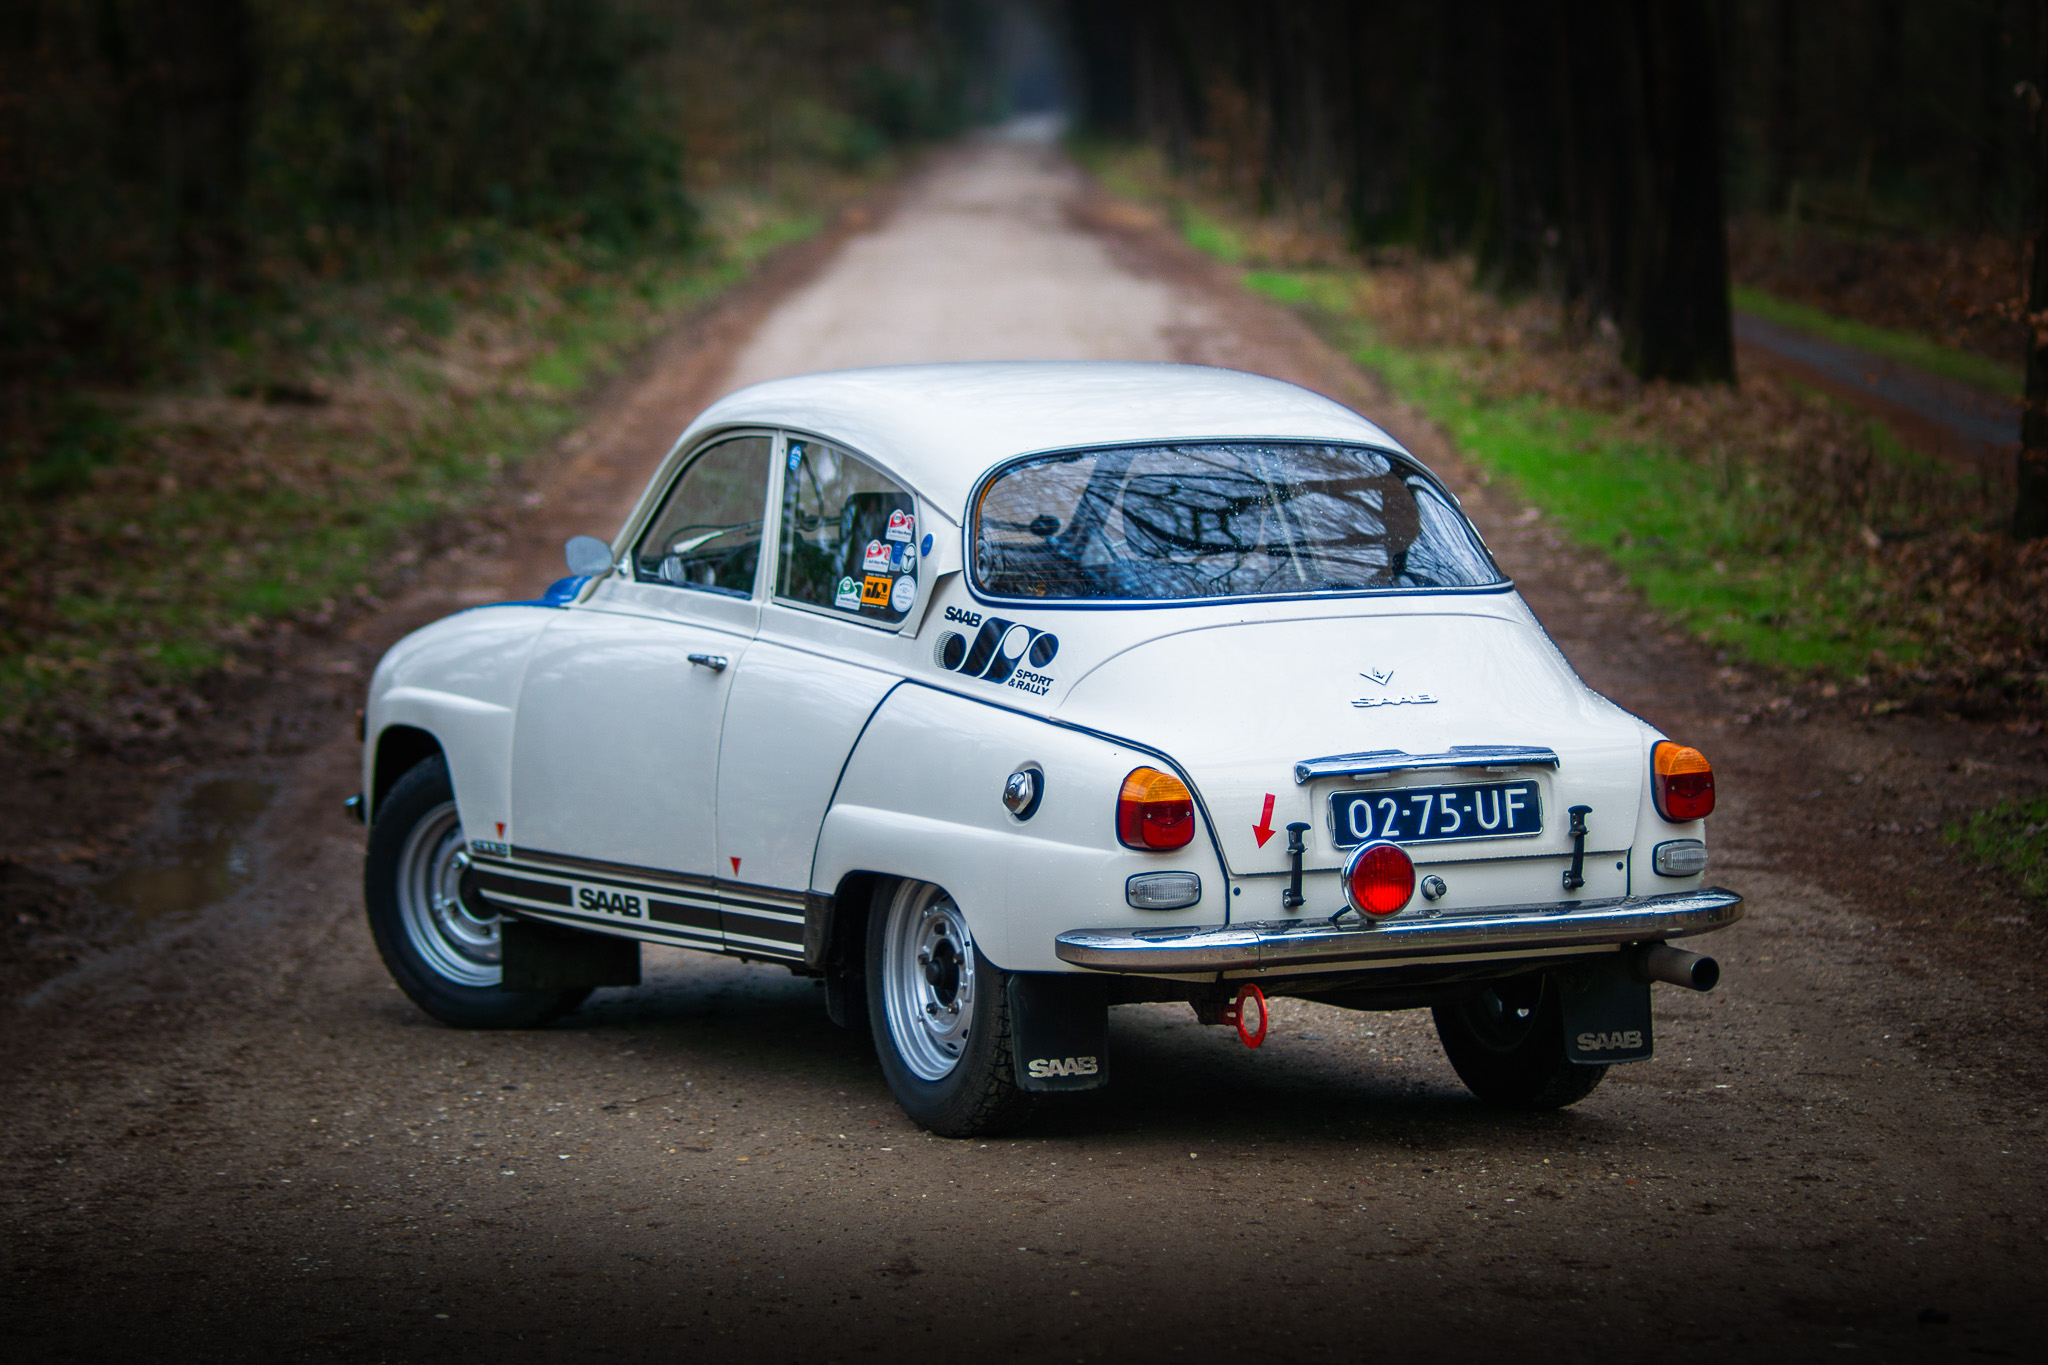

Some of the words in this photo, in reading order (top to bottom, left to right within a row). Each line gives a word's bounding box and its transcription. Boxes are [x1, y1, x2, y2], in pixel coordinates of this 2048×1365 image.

[944, 606, 982, 628] SAAB
[1015, 669, 1054, 688] SPORT
[1351, 693, 1438, 708] SAAB
[1348, 788, 1527, 838] 02-75-UF
[578, 888, 641, 918] SAAB
[1576, 1030, 1643, 1051] SAAB
[1028, 1056, 1098, 1078] SAAB
